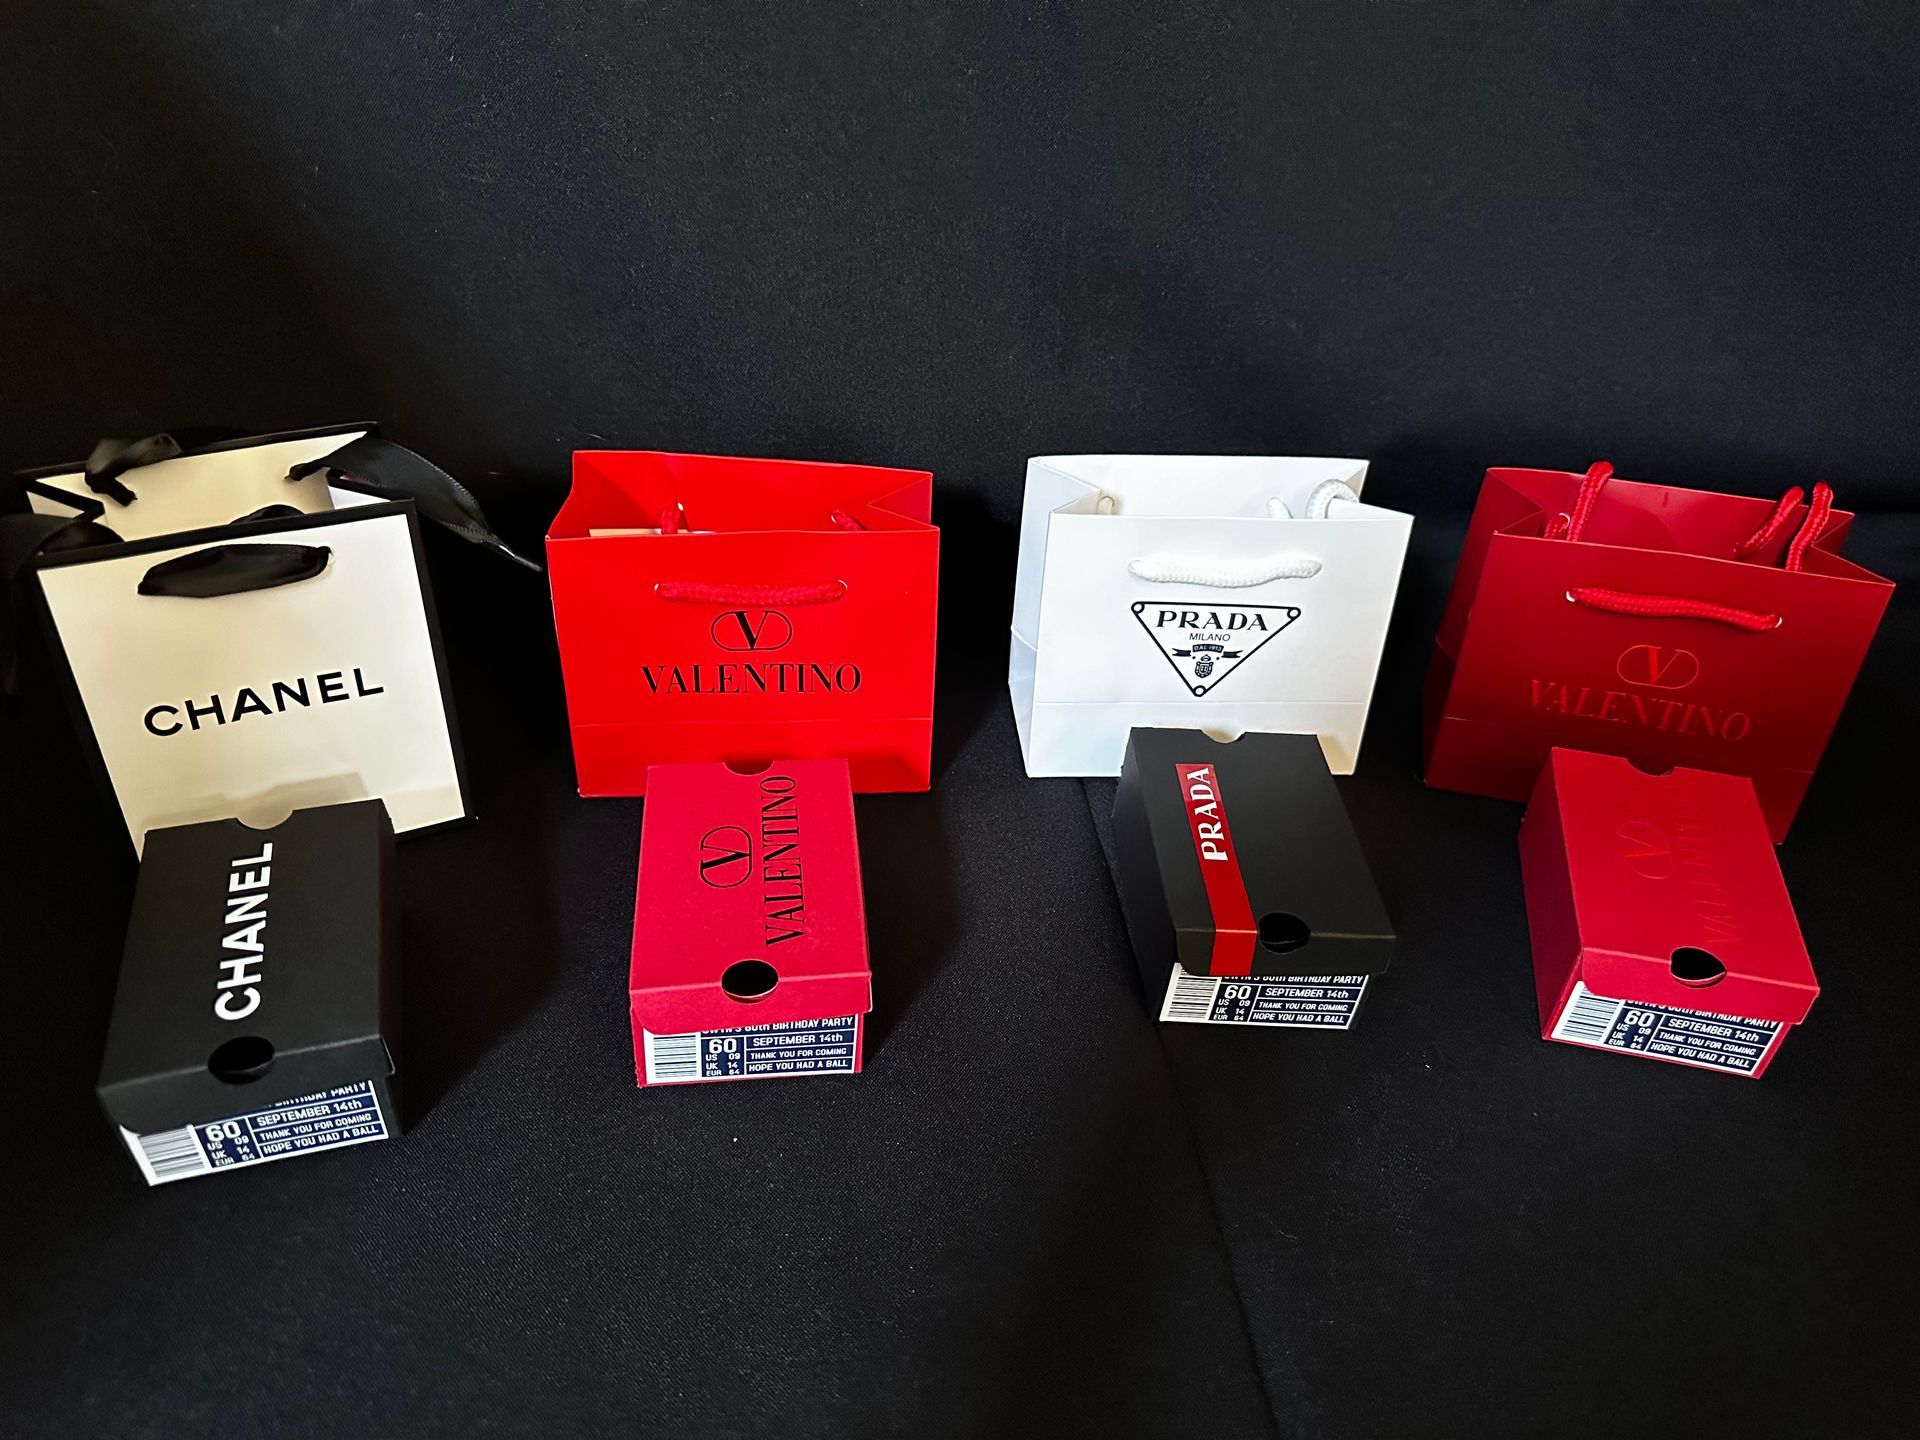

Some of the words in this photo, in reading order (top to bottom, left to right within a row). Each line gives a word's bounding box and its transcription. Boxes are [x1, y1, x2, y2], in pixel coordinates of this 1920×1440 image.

[1156, 610, 1268, 631] PRADA
[1189, 632, 1231, 642] MILANO
[640, 663, 862, 694] VALENTINO
[144, 667, 384, 737] CHANEL
[1532, 679, 1750, 742] VALENTINO
[1187, 768, 1228, 861] PRADA
[760, 776, 806, 947] VALENTINO
[214, 842, 273, 1021] CHANEL
[1333, 975, 1364, 984] PARTY
[1224, 985, 1252, 1000] 60
[1265, 987, 1324, 998] SEPTEMBER
[1326, 990, 1349, 999] 14th
[1258, 1001, 1283, 1009] THANK
[1285, 1002, 1300, 1010] YOU
[1301, 1003, 1316, 1011] FOR
[1317, 1003, 1349, 1012] COMING
[772, 1019, 819, 1031] BIRTHDAY
[822, 1016, 853, 1028] PARTY
[1252, 1012, 1276, 1021] HOPE
[1277, 1013, 1294, 1021] YOU
[1296, 1014, 1314, 1022] HAD
[1323, 1015, 1345, 1023] BALL
[1624, 1009, 1655, 1028] 60
[1616, 1023, 1630, 1032] US
[1638, 1027, 1651, 1036] 09
[1668, 1018, 1731, 1038] SEPTEMBER
[1735, 1030, 1760, 1043] 14th
[753, 1035, 816, 1047] SEPTEMBER
[819, 1033, 843, 1043] 14th
[1608, 1038, 1625, 1047] EUR
[1612, 1031, 1625, 1040] UK
[1633, 1035, 1644, 1044] 14
[1659, 1031, 1686, 1043] THANK
[1687, 1037, 1704, 1047] YOU
[1704, 1040, 1722, 1050] FOR
[1722, 1043, 1757, 1056] COMING
[708, 1038, 737, 1054] 60
[750, 1051, 777, 1060] THANK
[779, 1050, 796, 1058] YOU
[797, 1049, 814, 1057] FOR
[815, 1047, 847, 1056] COMING
[705, 1053, 718, 1061] US
[728, 1052, 741, 1060] 09
[1650, 1043, 1676, 1054] HOPE
[1677, 1047, 1696, 1057] YOU
[1697, 1051, 1717, 1062] HAD
[1717, 1054, 1725, 1063] A
[1726, 1057, 1751, 1068] BALL
[706, 1062, 718, 1070] UK
[727, 1061, 738, 1069] 14
[749, 1063, 773, 1072] HOPE
[775, 1061, 794, 1070] YOU
[796, 1061, 815, 1069] HAD
[825, 1059, 848, 1068] BALL
[257, 1105, 331, 1127] SEPTEMBER
[334, 1099, 362, 1113] 14th
[205, 1121, 242, 1142] 60
[260, 1128, 291, 1141] THANK
[293, 1124, 313, 1135] YOU
[314, 1120, 333, 1131] FOR
[335, 1112, 372, 1127] COMING
[207, 1141, 223, 1151] US
[234, 1135, 249, 1146] 09
[263, 1142, 293, 1155] HOPE
[294, 1137, 316, 1149] YOU
[318, 1132, 340, 1144] HAD
[342, 1130, 351, 1139] A
[354, 1125, 379, 1137] BALL
[211, 1150, 227, 1160] UK
[237, 1146, 250, 1155] 14
[215, 1156, 235, 1167] EUR
[241, 1153, 256, 1162] 64
